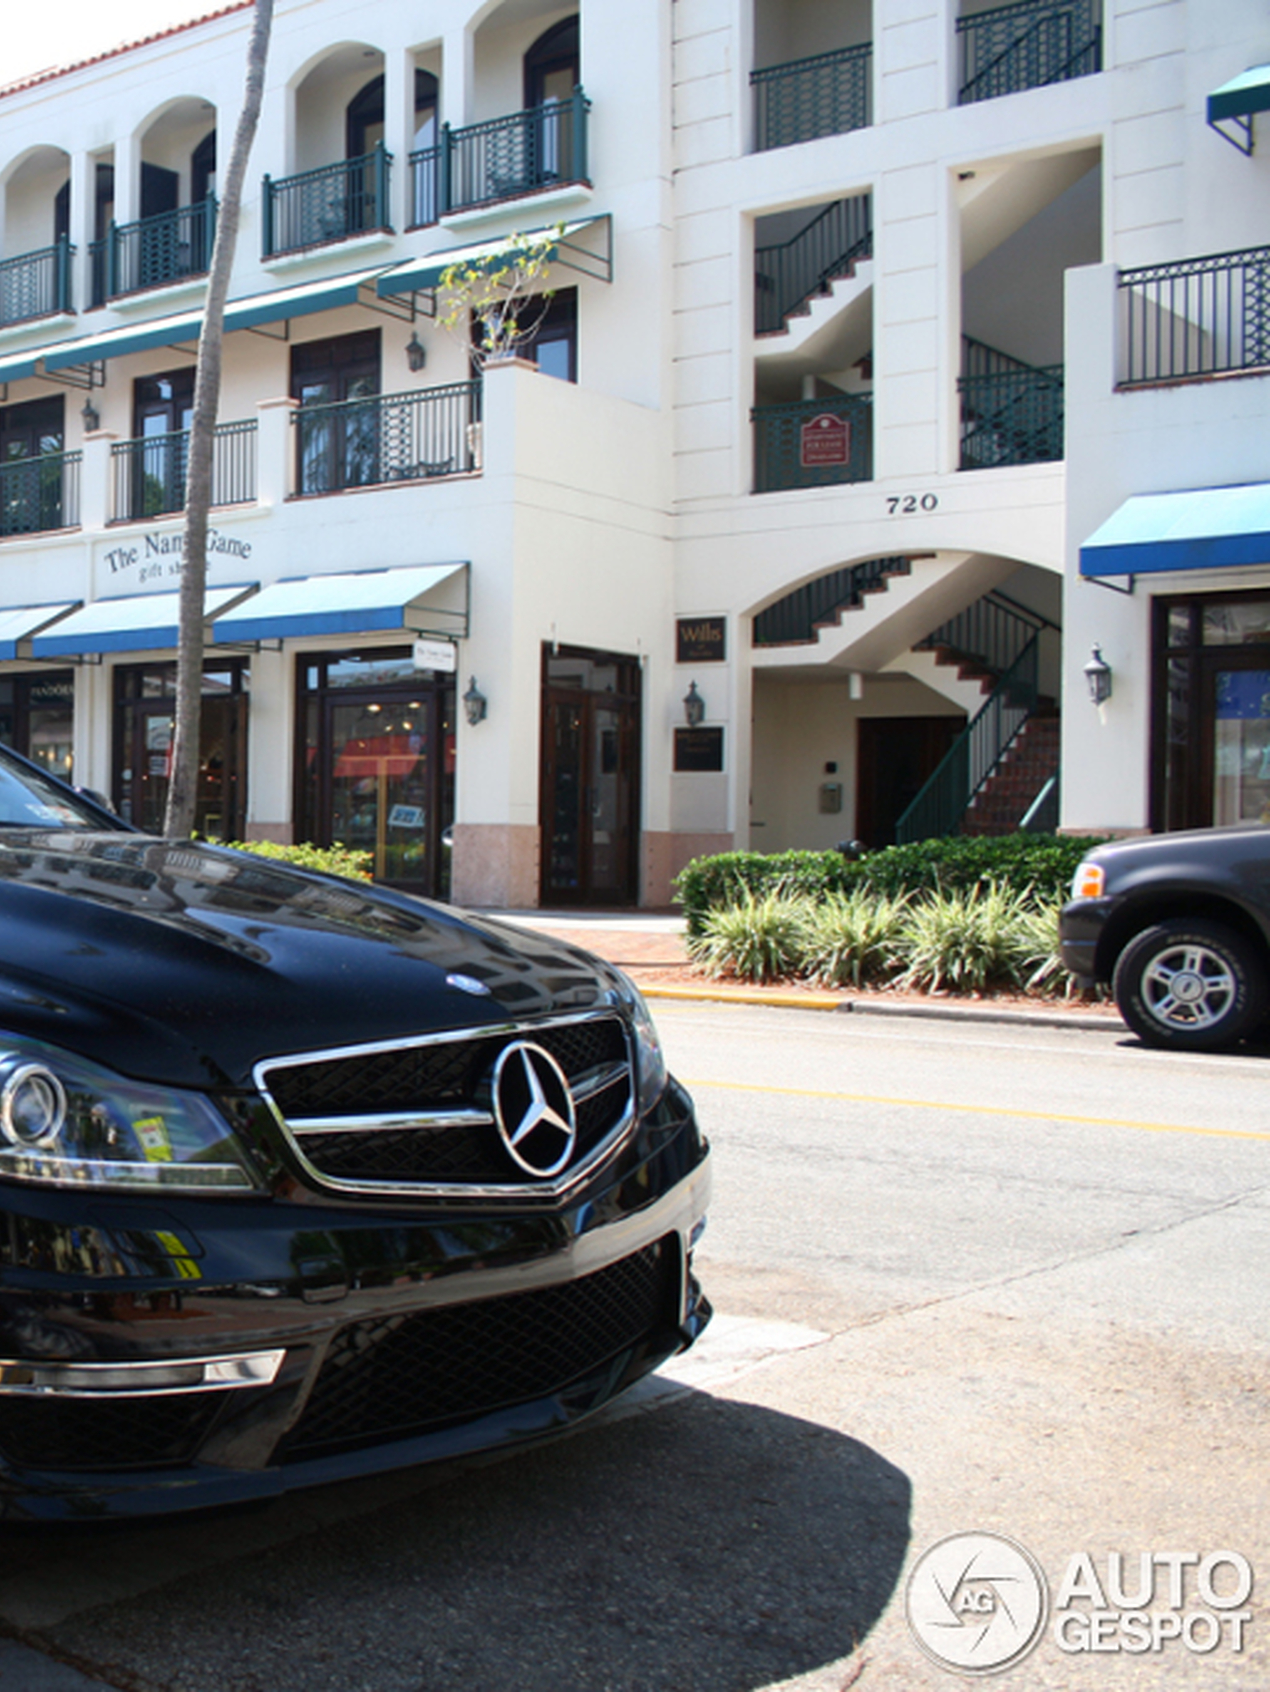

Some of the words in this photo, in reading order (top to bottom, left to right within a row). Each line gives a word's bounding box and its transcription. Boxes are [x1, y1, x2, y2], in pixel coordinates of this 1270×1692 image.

[886, 493, 939, 514] 720
[104, 547, 138, 573] The
[145, 531, 184, 558] Nam
[206, 528, 252, 559] Game
[139, 562, 162, 583] gift
